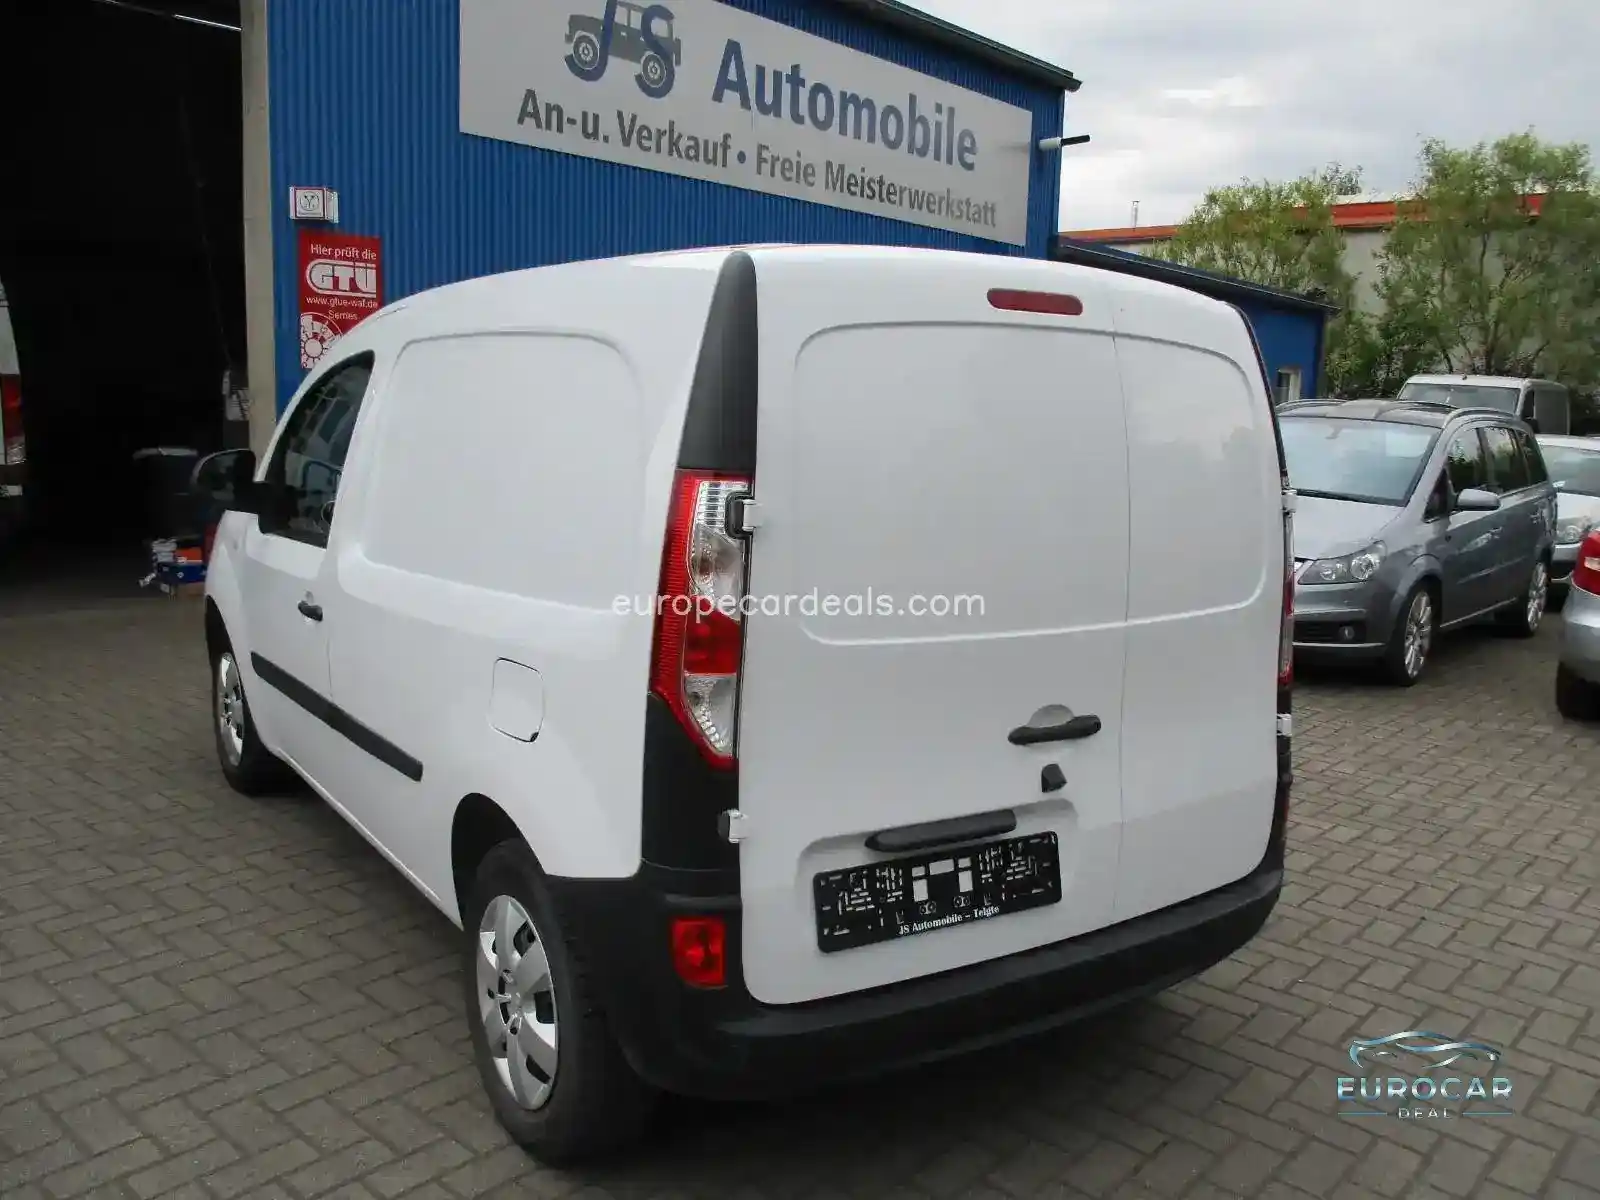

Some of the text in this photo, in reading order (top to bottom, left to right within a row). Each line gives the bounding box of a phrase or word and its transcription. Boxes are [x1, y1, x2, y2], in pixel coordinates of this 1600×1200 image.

[712, 38, 978, 171] Automobile
[617, 110, 732, 168] Verkauf
[756, 142, 816, 188] Freie
[824, 160, 997, 228] Meisterwerkstatt
[310, 243, 377, 260] Hier prüft die
[899, 924, 910, 935] JS
[912, 913, 963, 932] Automobile
